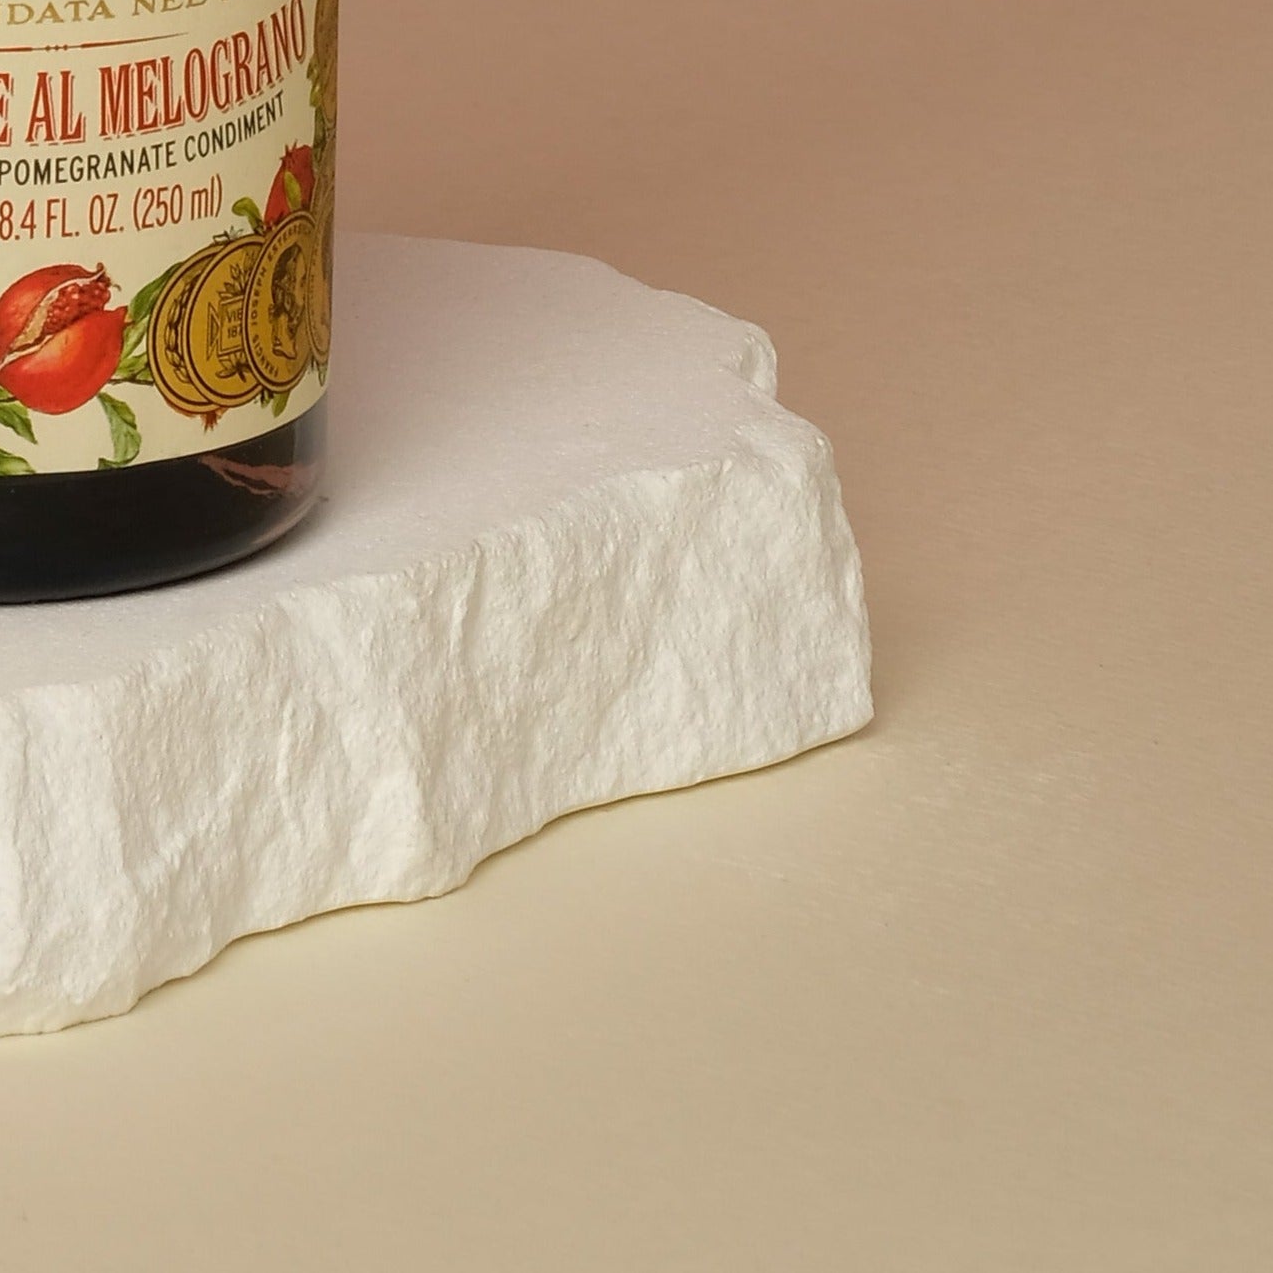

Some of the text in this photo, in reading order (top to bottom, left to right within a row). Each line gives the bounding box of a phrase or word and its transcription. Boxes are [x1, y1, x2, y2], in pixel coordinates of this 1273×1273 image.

[25, 70, 86, 146] AL
[185, 92, 285, 161] CONDIMENT
[46, 196, 80, 237] FL.
[89, 191, 126, 233] OZ.
[133, 184, 181, 231] (250
[191, 173, 223, 220] ml)
